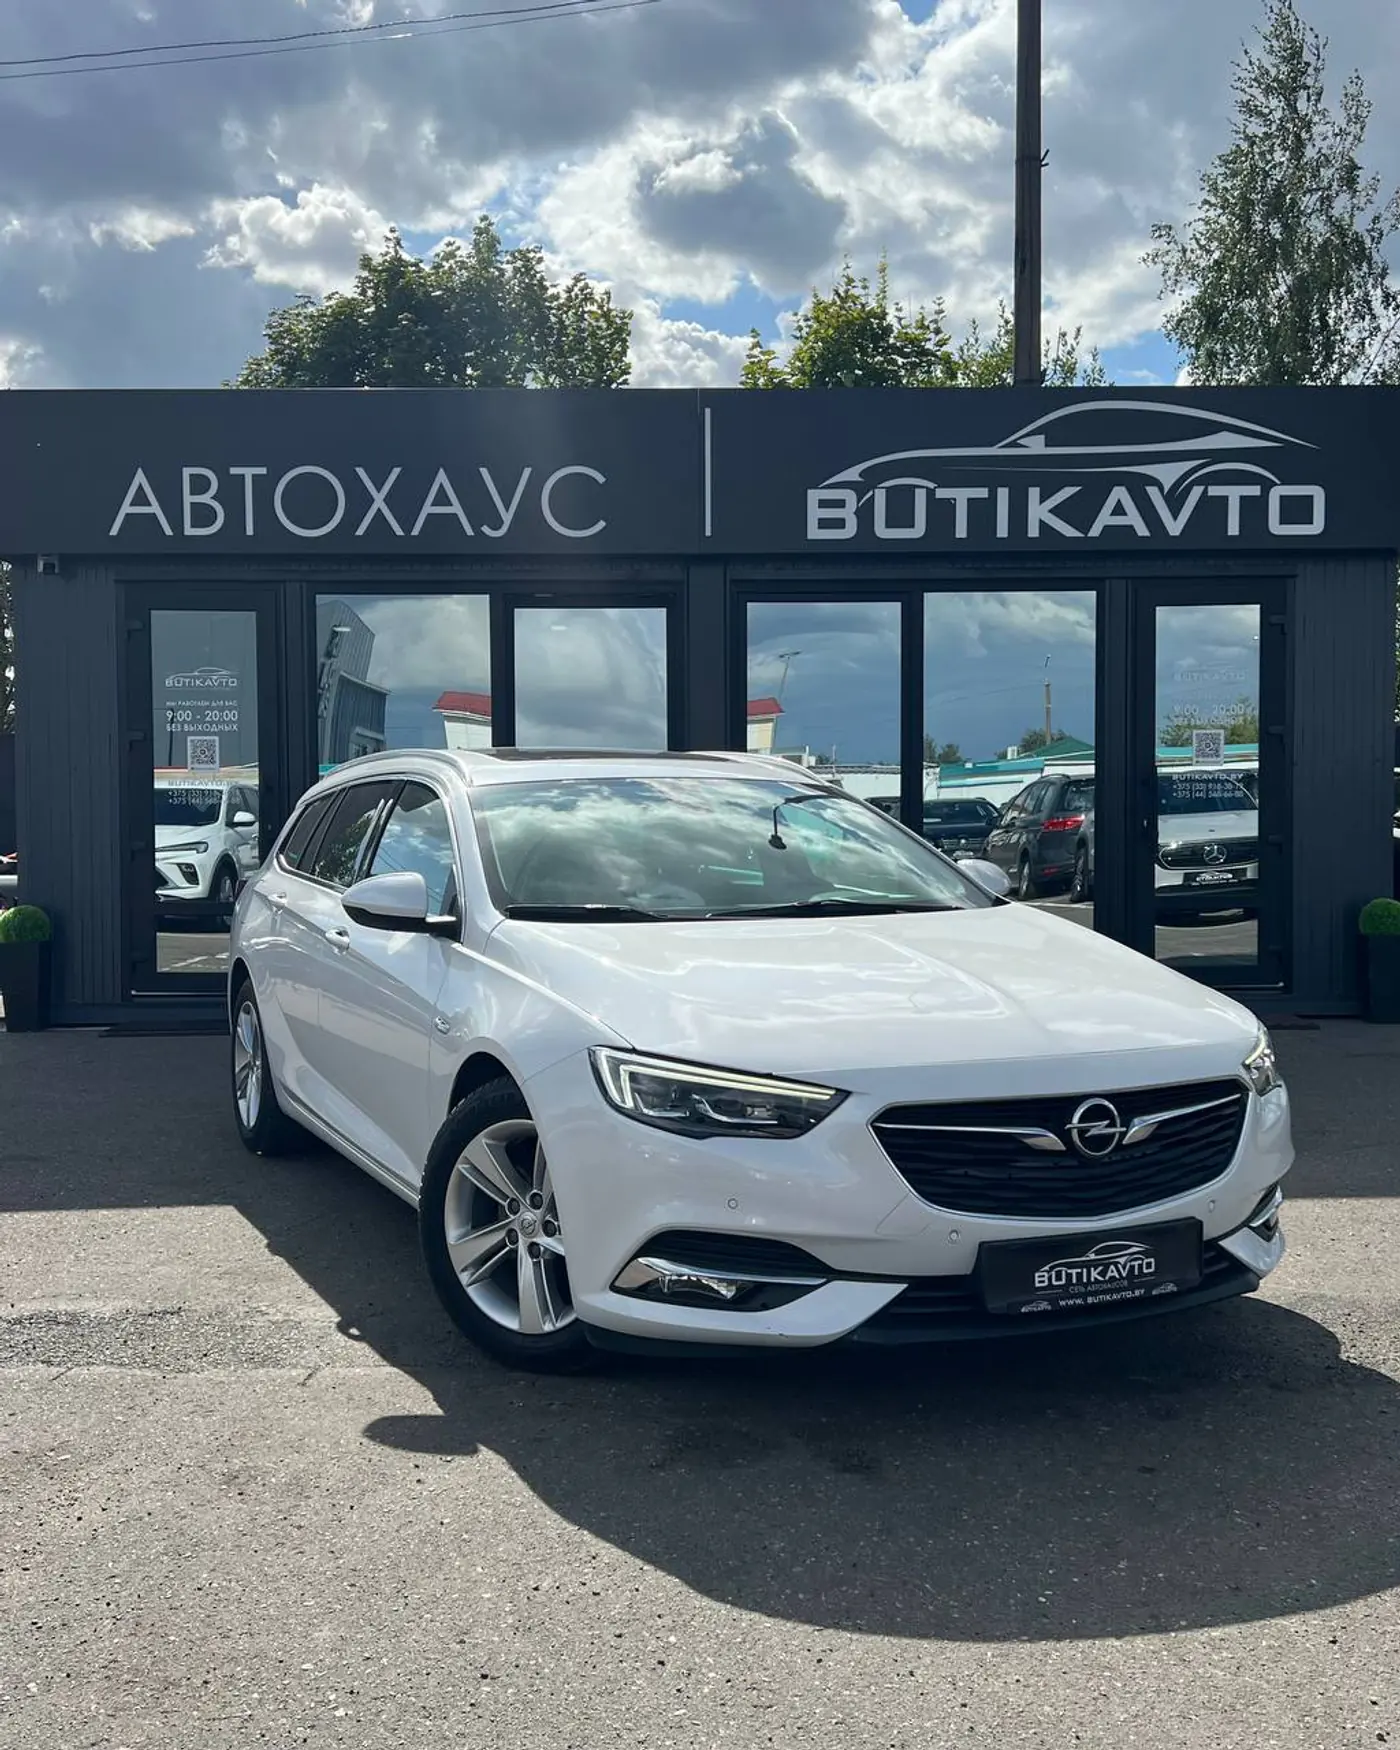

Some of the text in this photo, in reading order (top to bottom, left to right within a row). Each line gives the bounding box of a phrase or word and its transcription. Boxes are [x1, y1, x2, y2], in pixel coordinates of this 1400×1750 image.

[109, 465, 607, 538] АВТОХАУС
[805, 484, 1326, 541] BUTIKAVTO
[165, 678, 238, 687] BUTIKAVTO
[165, 710, 193, 721] 9:00
[204, 710, 239, 721] 20:00
[183, 723, 239, 732] ВЫХОДНЫХ
[1034, 1257, 1155, 1287] BUTIKAVTO
